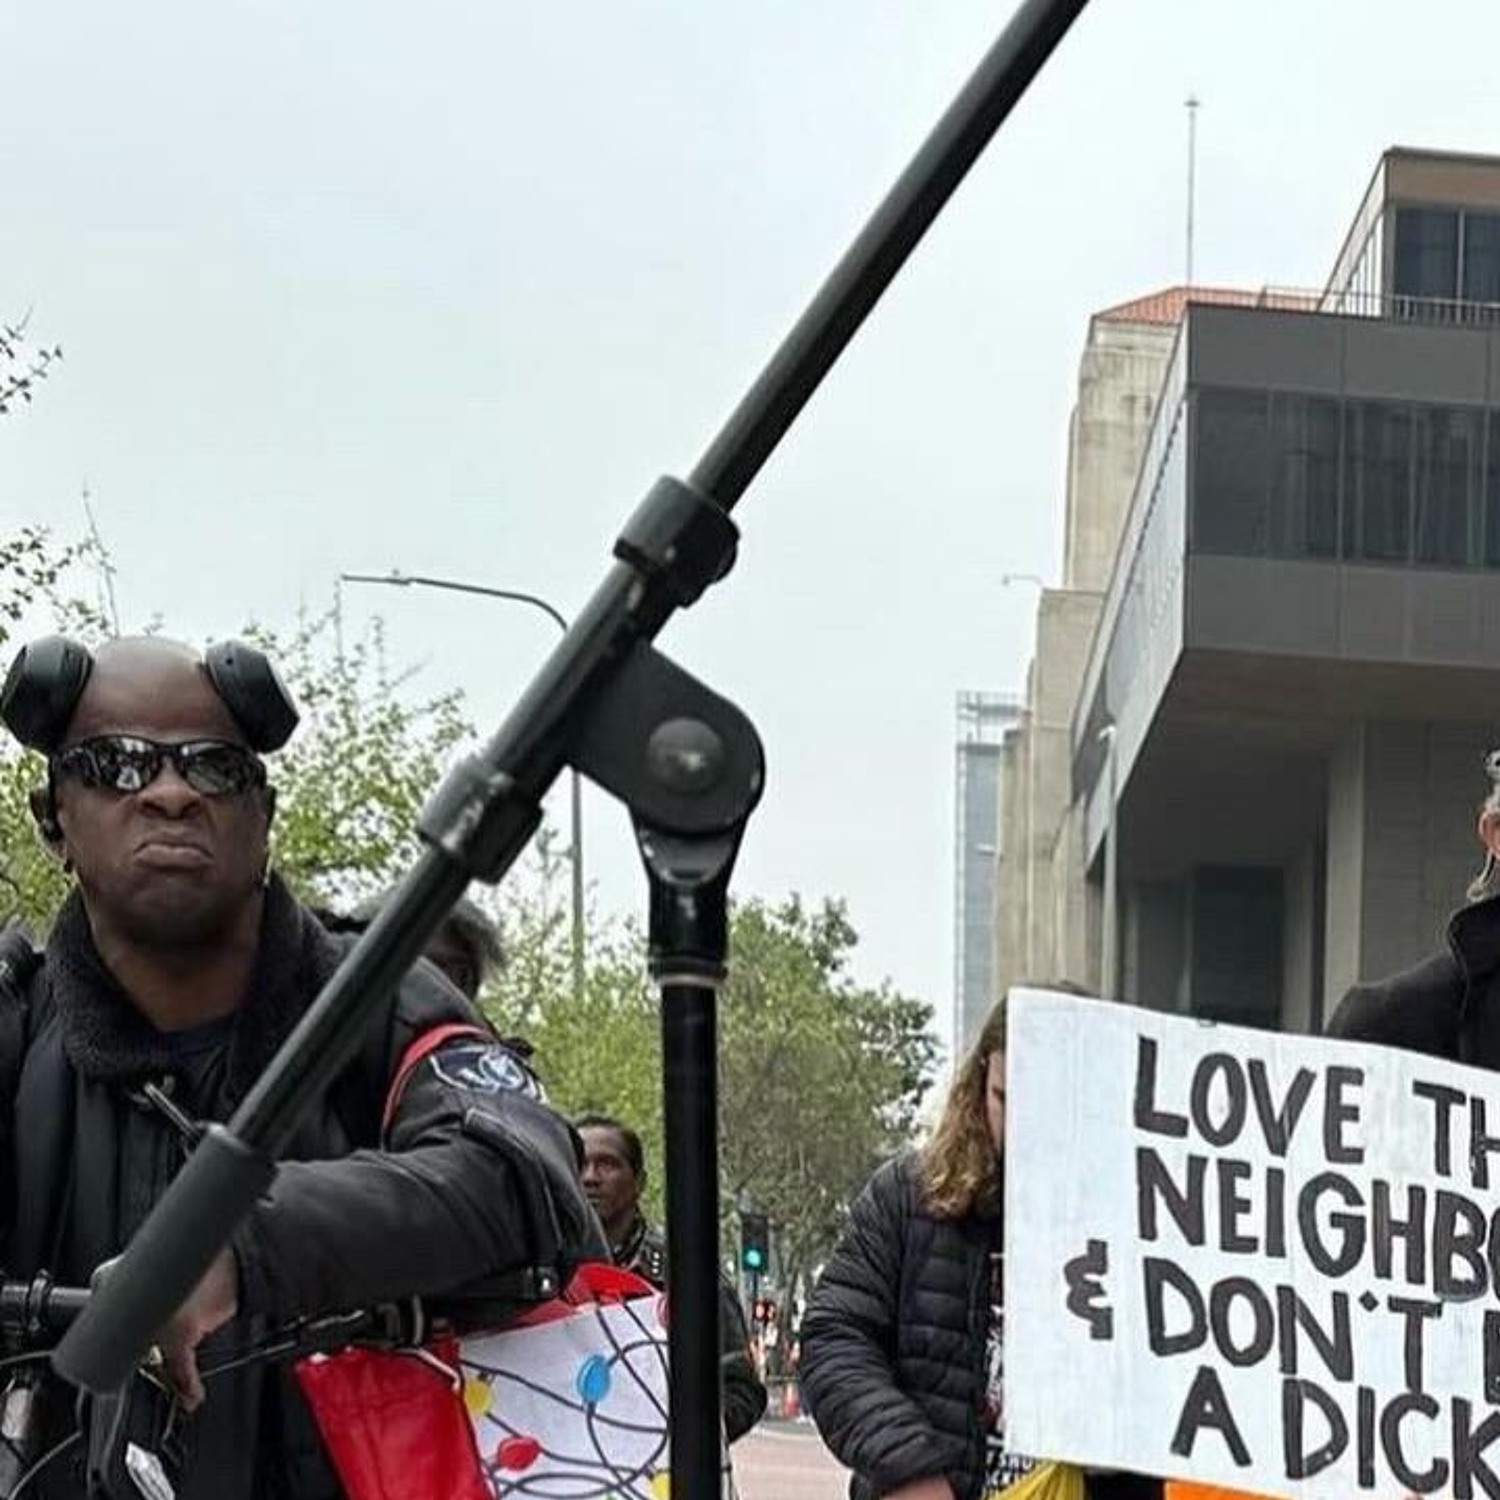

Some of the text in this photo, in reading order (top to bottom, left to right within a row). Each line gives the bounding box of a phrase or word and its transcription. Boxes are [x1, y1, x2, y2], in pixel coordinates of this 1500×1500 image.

[1133, 1034, 1365, 1164] LOVE
[1063, 1239, 1114, 1340] &
[1142, 1256, 1443, 1396] DON'T
[1170, 1366, 1252, 1467] A
